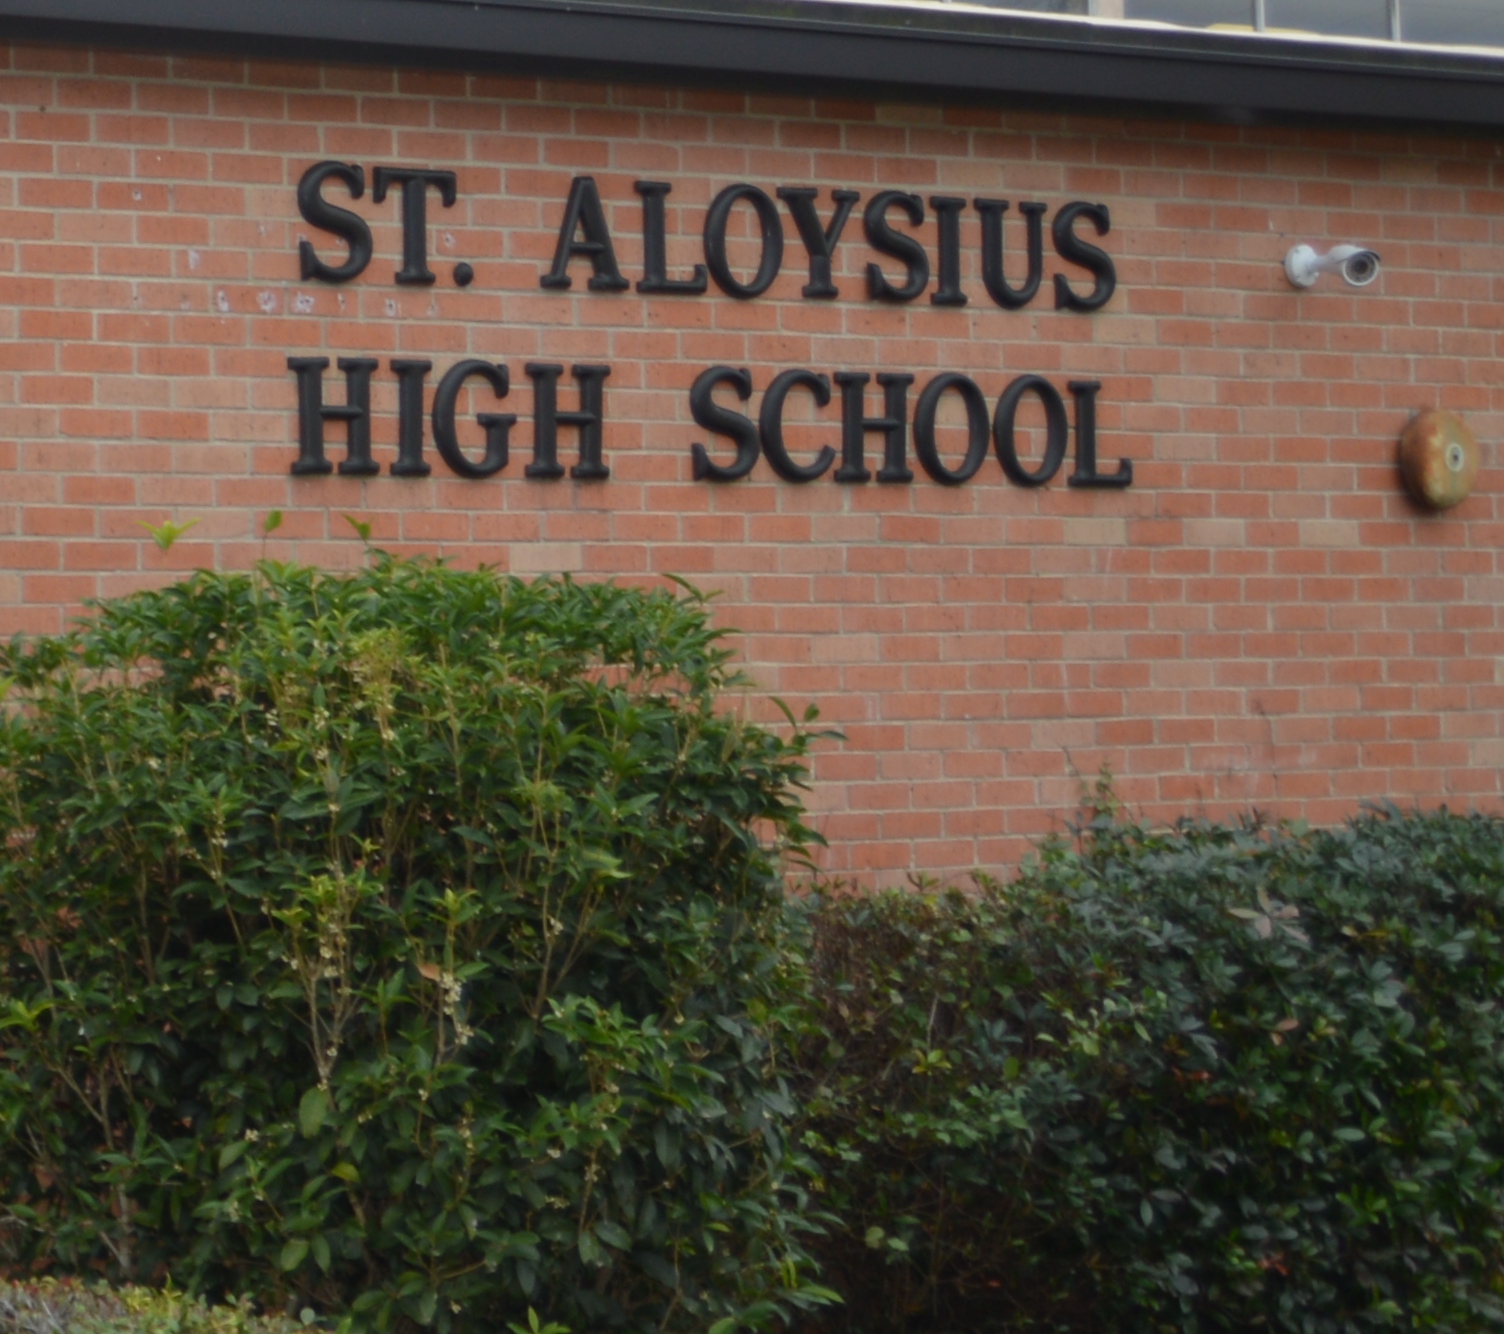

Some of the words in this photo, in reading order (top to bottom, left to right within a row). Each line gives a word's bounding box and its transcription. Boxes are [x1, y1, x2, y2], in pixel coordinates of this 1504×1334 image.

[296, 160, 473, 287] ST.
[539, 175, 1118, 313] ALOYSIUS
[287, 356, 612, 480] HIGH
[690, 364, 1133, 489] SCHOOL
